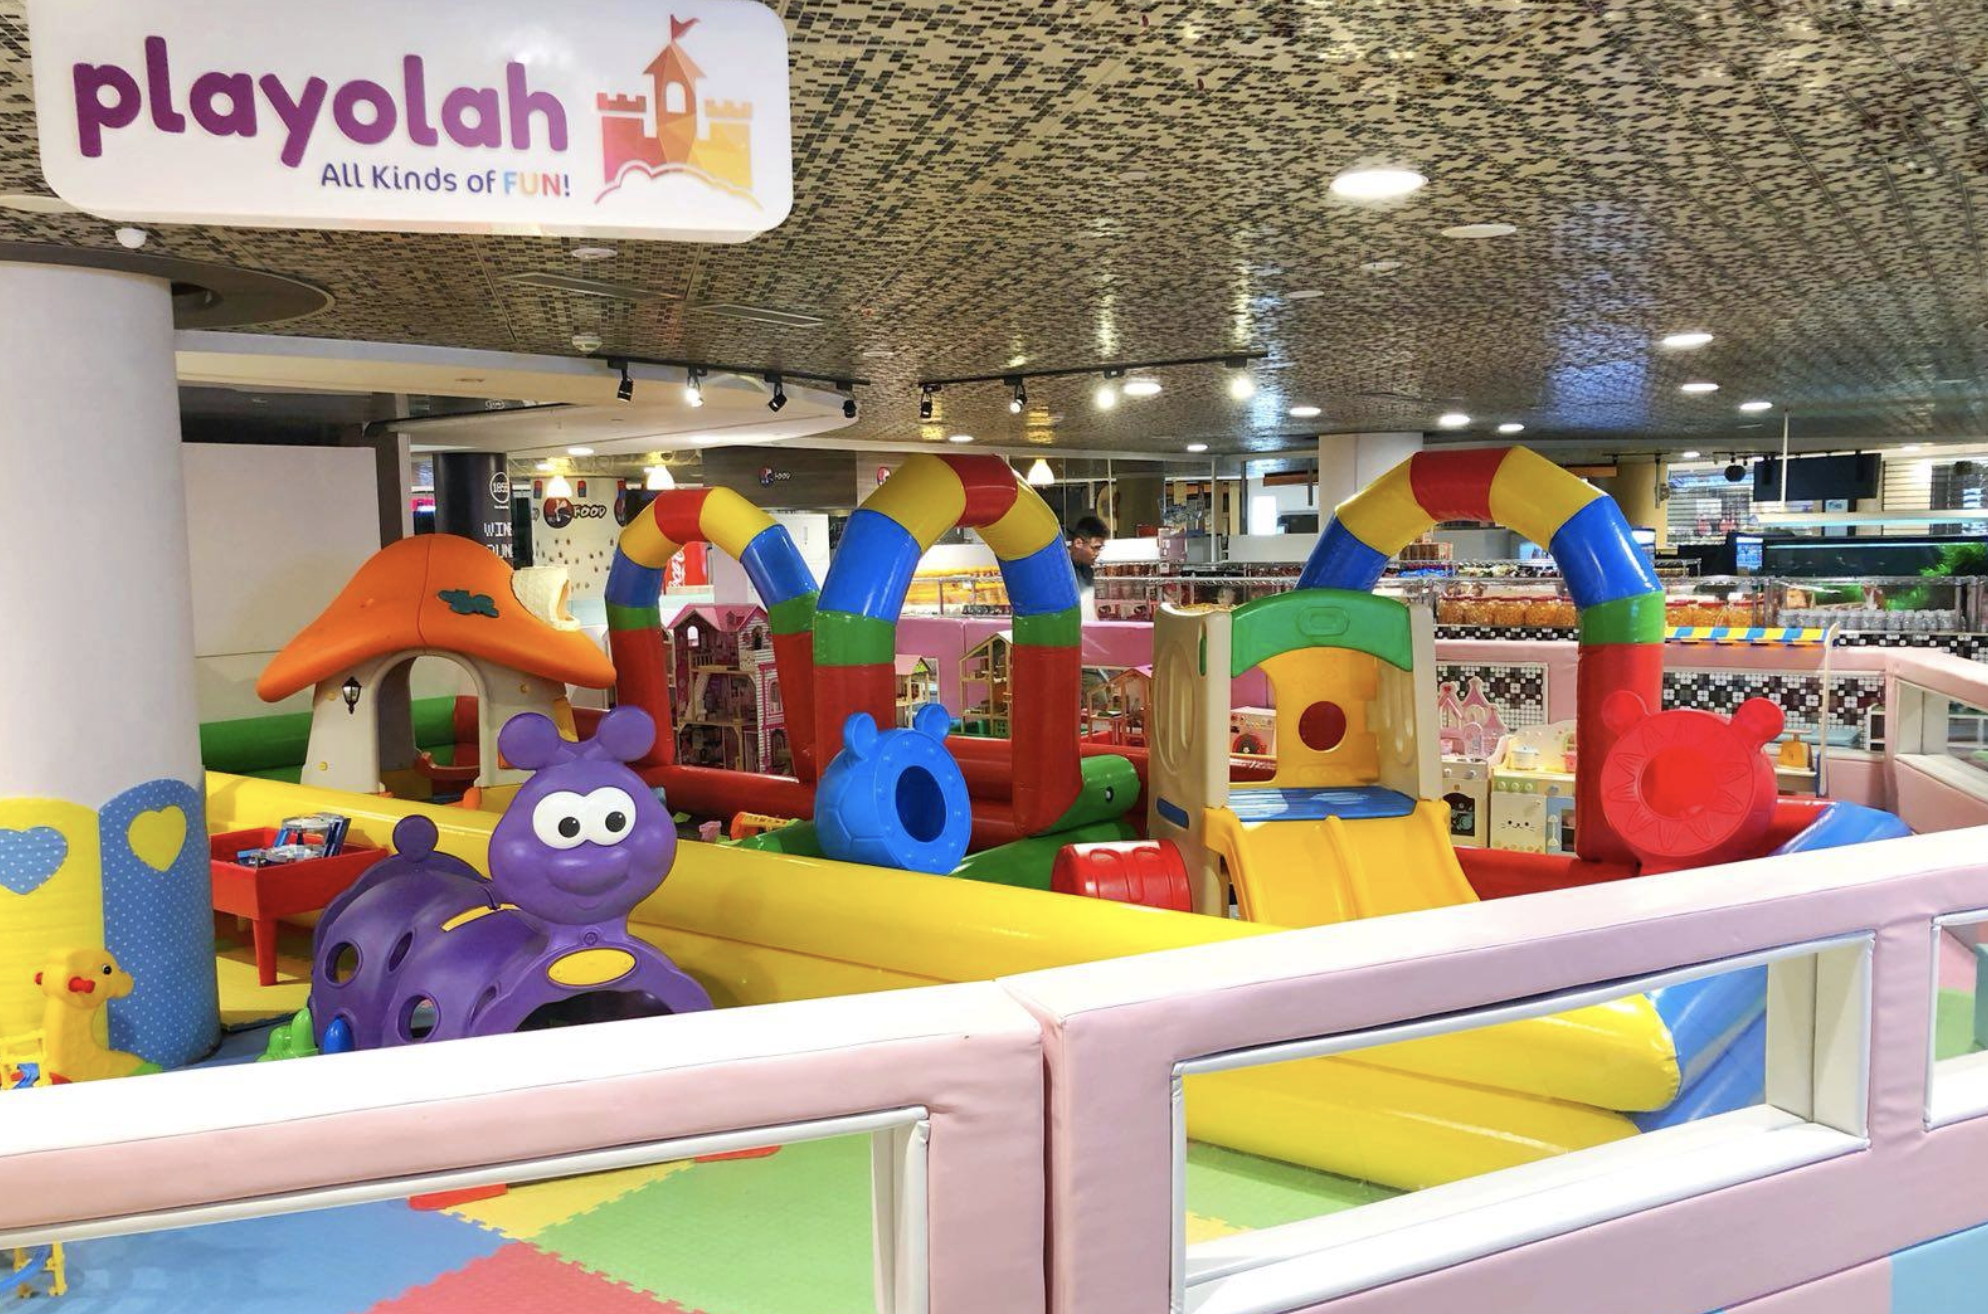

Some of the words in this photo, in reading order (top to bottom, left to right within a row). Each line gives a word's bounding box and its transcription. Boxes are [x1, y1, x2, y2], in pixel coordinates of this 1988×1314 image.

[72, 35, 569, 168] playolah
[321, 163, 364, 188] All
[371, 165, 457, 192] Kinds
[467, 170, 496, 193] of
[504, 171, 570, 197] FUN!
[572, 505, 607, 519] FOOD
